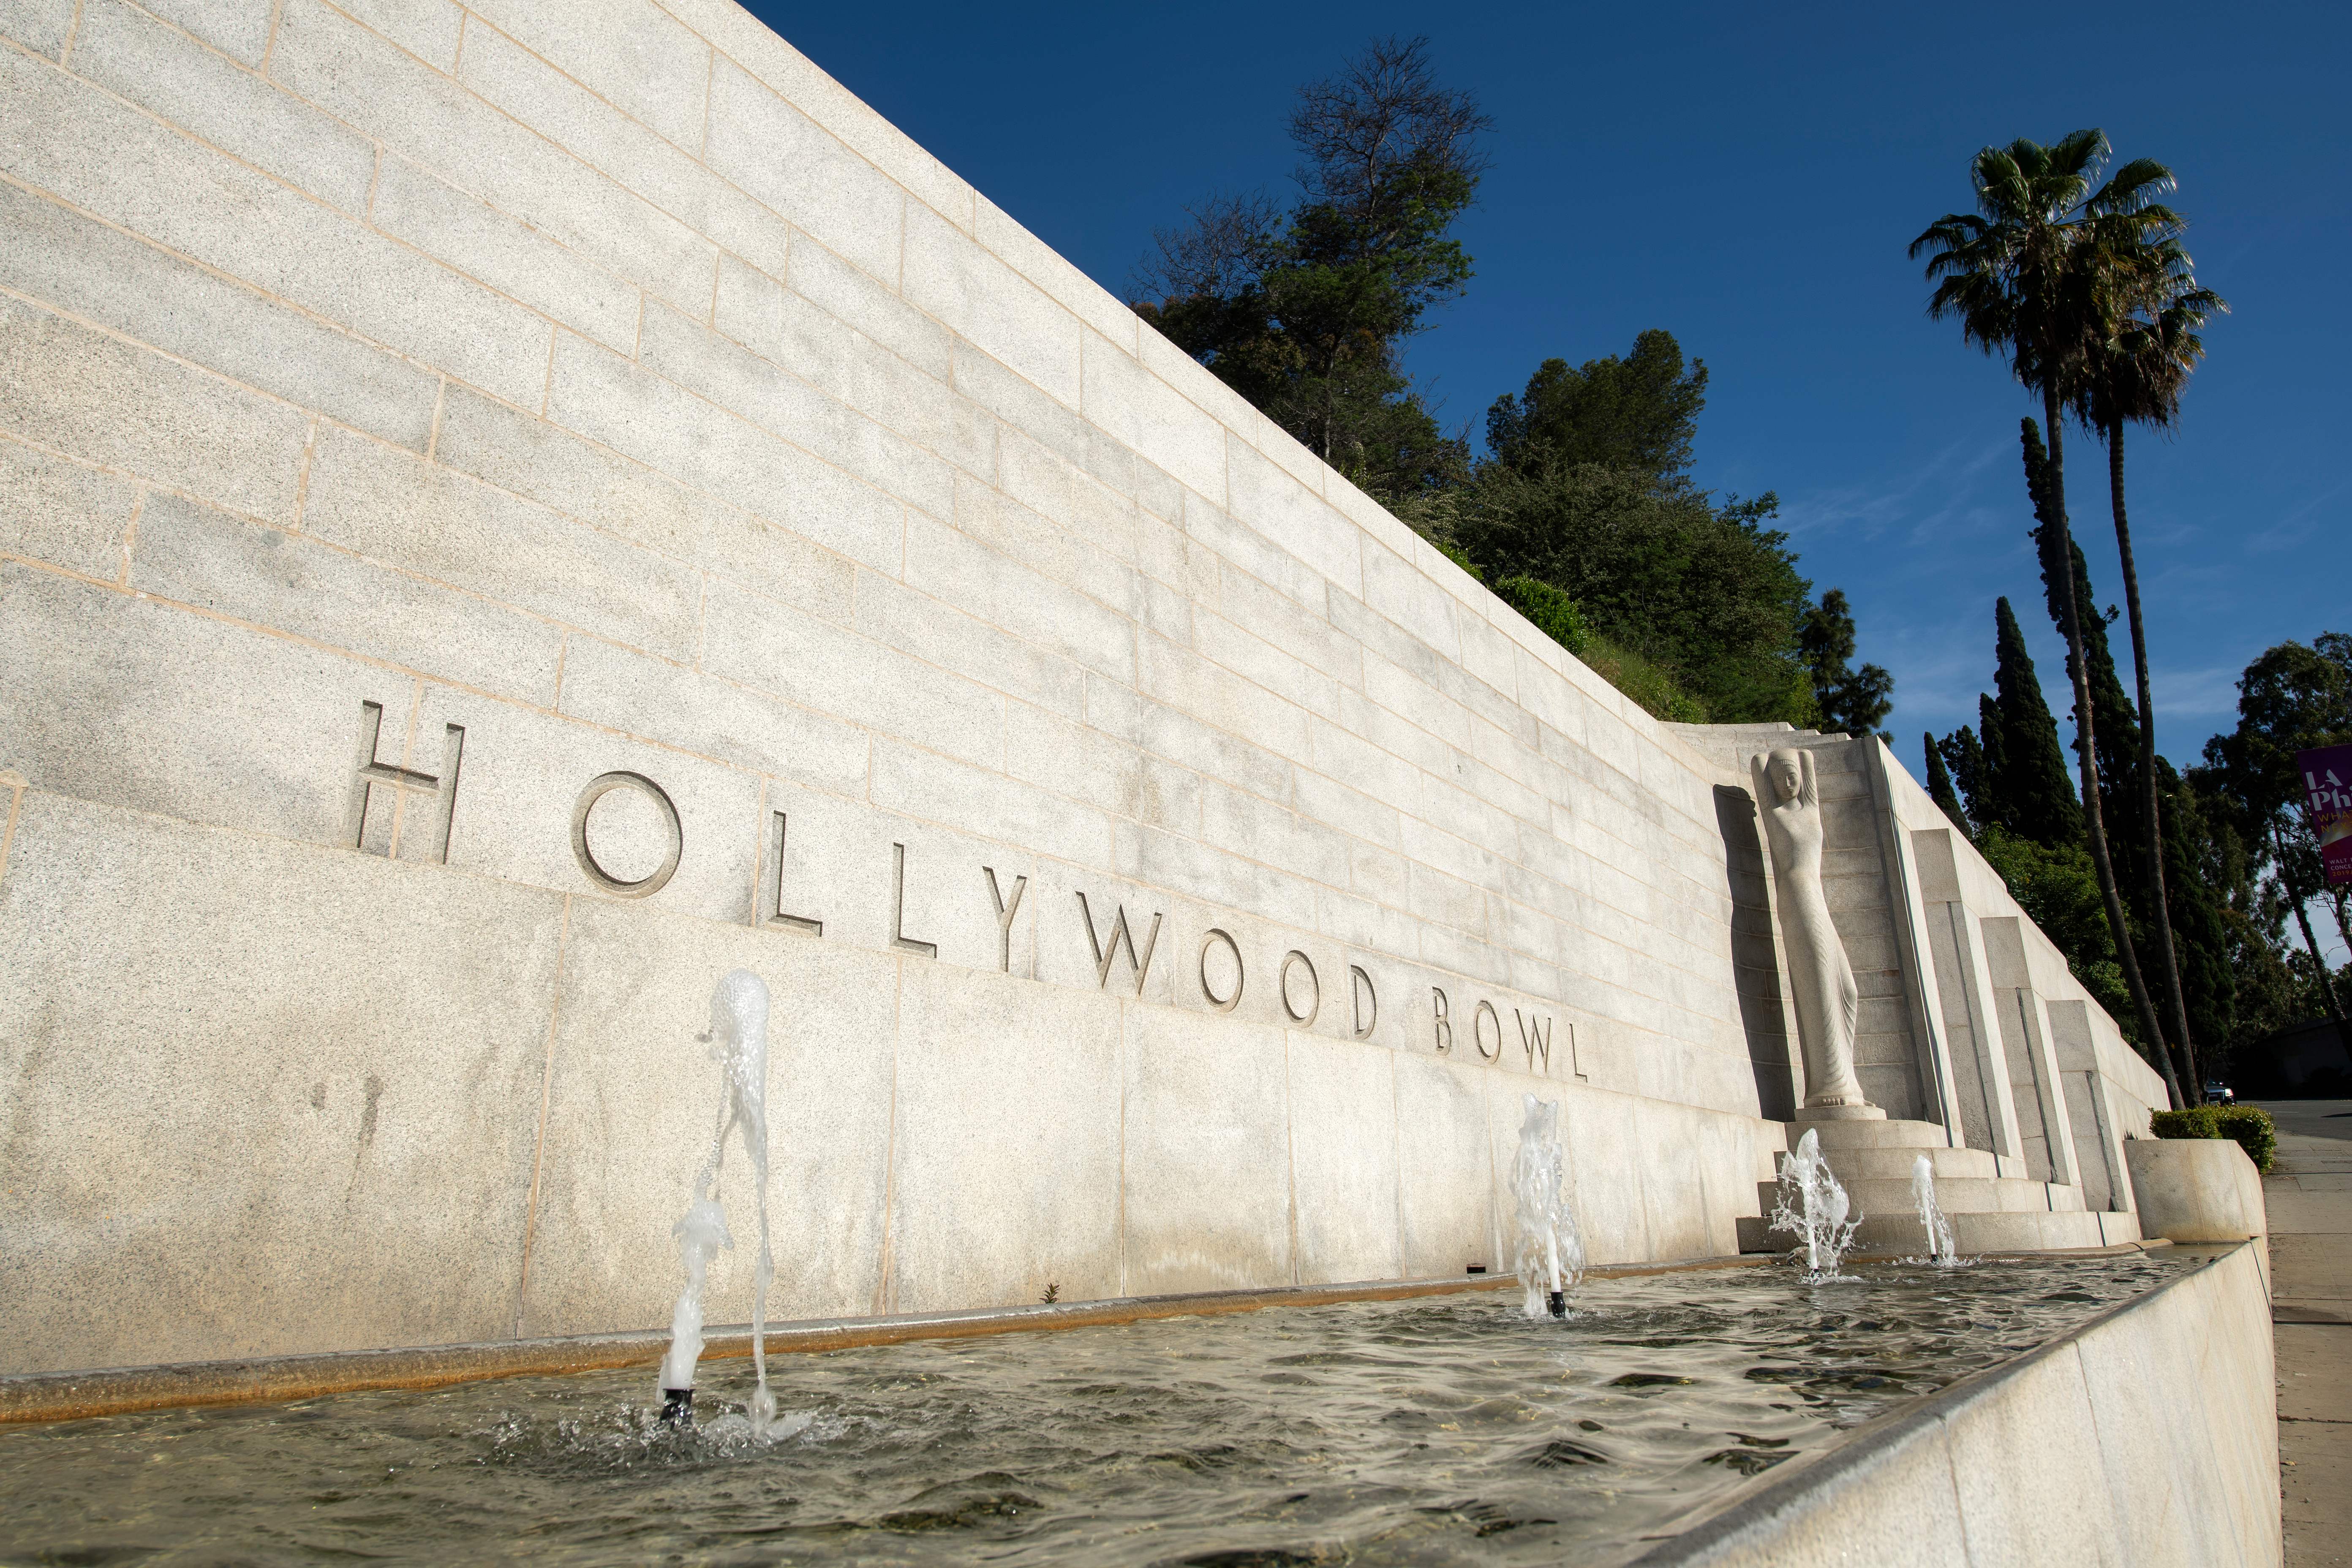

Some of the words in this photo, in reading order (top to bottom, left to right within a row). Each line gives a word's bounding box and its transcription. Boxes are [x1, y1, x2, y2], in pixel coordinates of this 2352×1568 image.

[2305, 769, 2343, 790] LA
[342, 699, 1377, 1040] HOLLYWOOD
[1432, 986, 1587, 1083] BOWL
